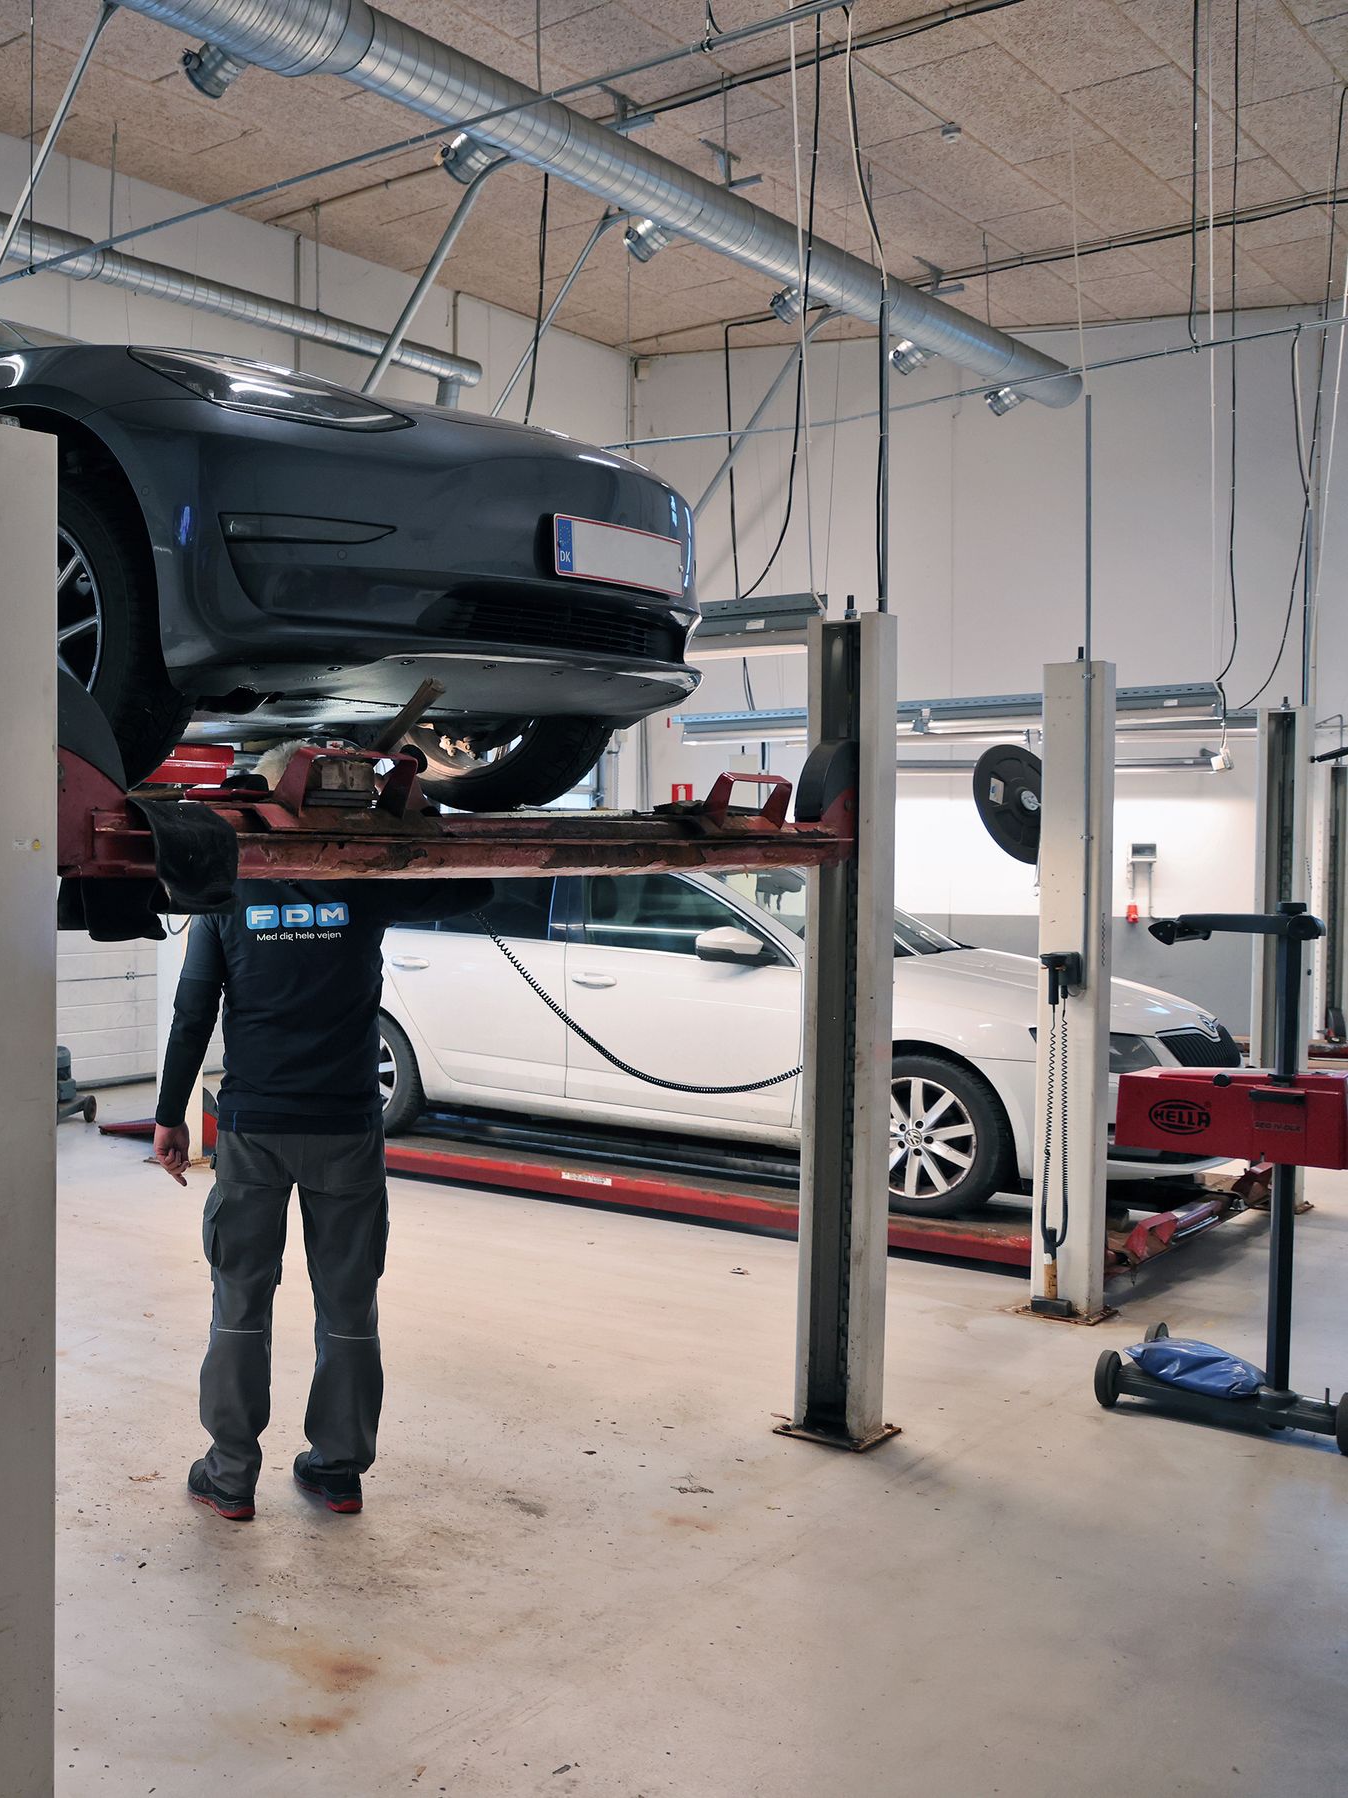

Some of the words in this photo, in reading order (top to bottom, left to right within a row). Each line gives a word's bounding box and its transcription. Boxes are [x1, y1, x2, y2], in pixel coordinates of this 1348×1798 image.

[559, 550, 571, 563] DK
[251, 906, 345, 925] FDM
[256, 933, 278, 942] Med
[279, 931, 294, 942] dig
[295, 931, 315, 940] hele
[316, 930, 342, 941] vejen
[1154, 1110, 1212, 1128] HELLA
